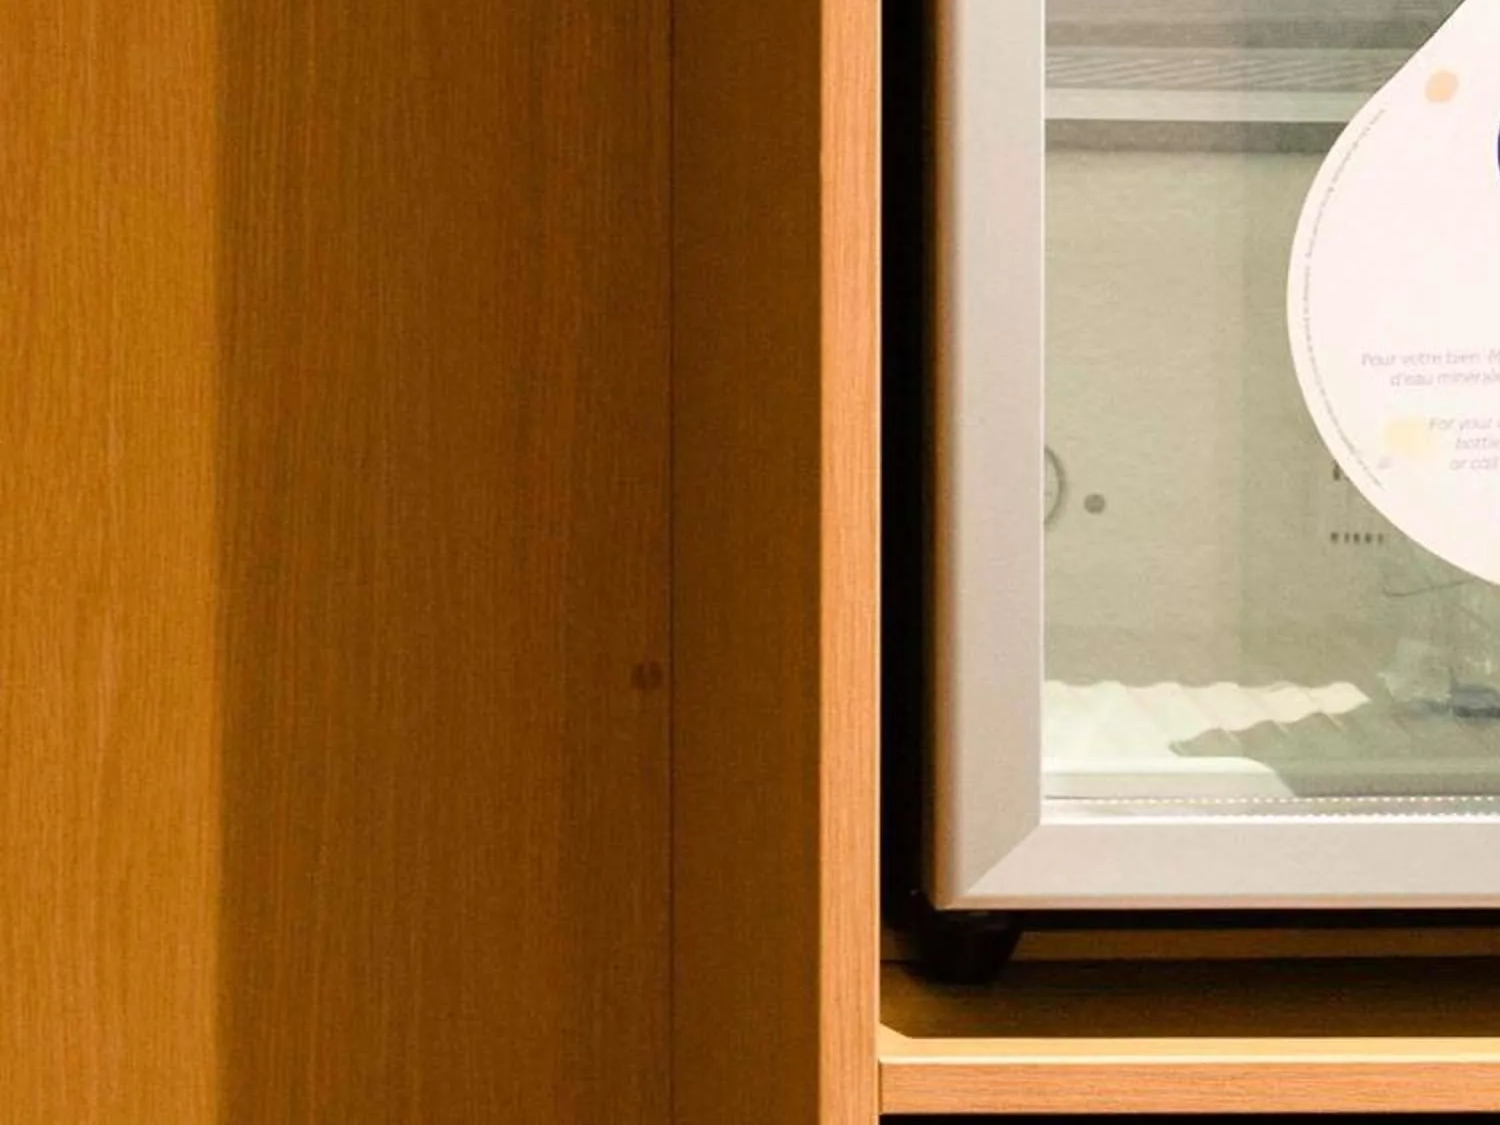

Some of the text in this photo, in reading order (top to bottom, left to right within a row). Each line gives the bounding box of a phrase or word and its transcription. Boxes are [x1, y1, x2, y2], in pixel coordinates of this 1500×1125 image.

[1361, 352, 1397, 367] Pour
[1428, 416, 1455, 431] For
[1458, 417, 1493, 433] your
[1455, 434, 1500, 451] bottle
[1450, 458, 1467, 471] or
[1470, 454, 1499, 470] call
